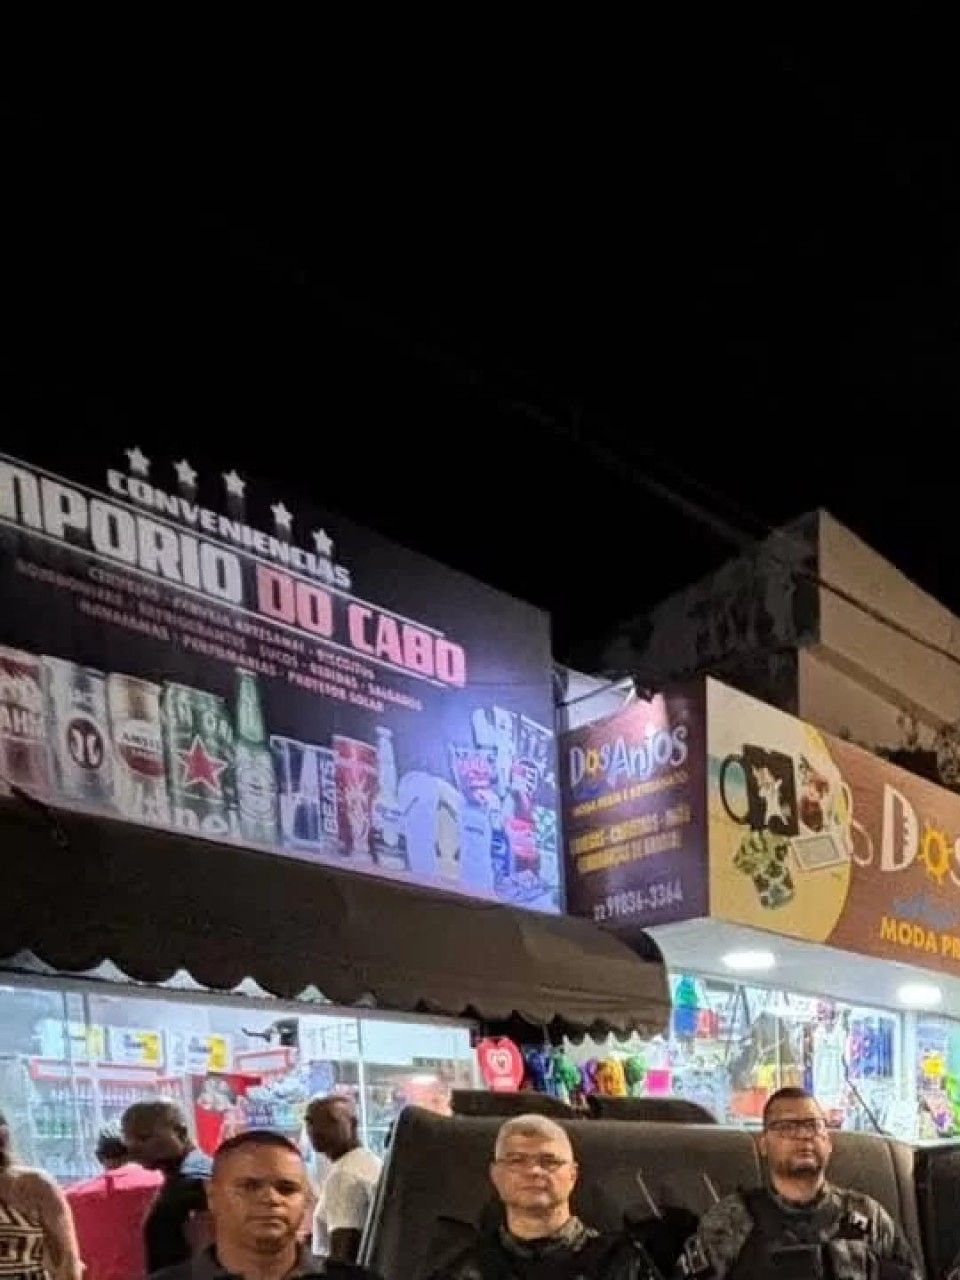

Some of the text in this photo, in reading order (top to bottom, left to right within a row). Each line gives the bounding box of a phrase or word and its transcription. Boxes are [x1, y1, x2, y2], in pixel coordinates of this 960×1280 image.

[107, 468, 351, 590] CONVENIENCIAS
[256, 561, 335, 638] DO
[348, 602, 467, 691] CABO
[879, 915, 939, 954] MODA
